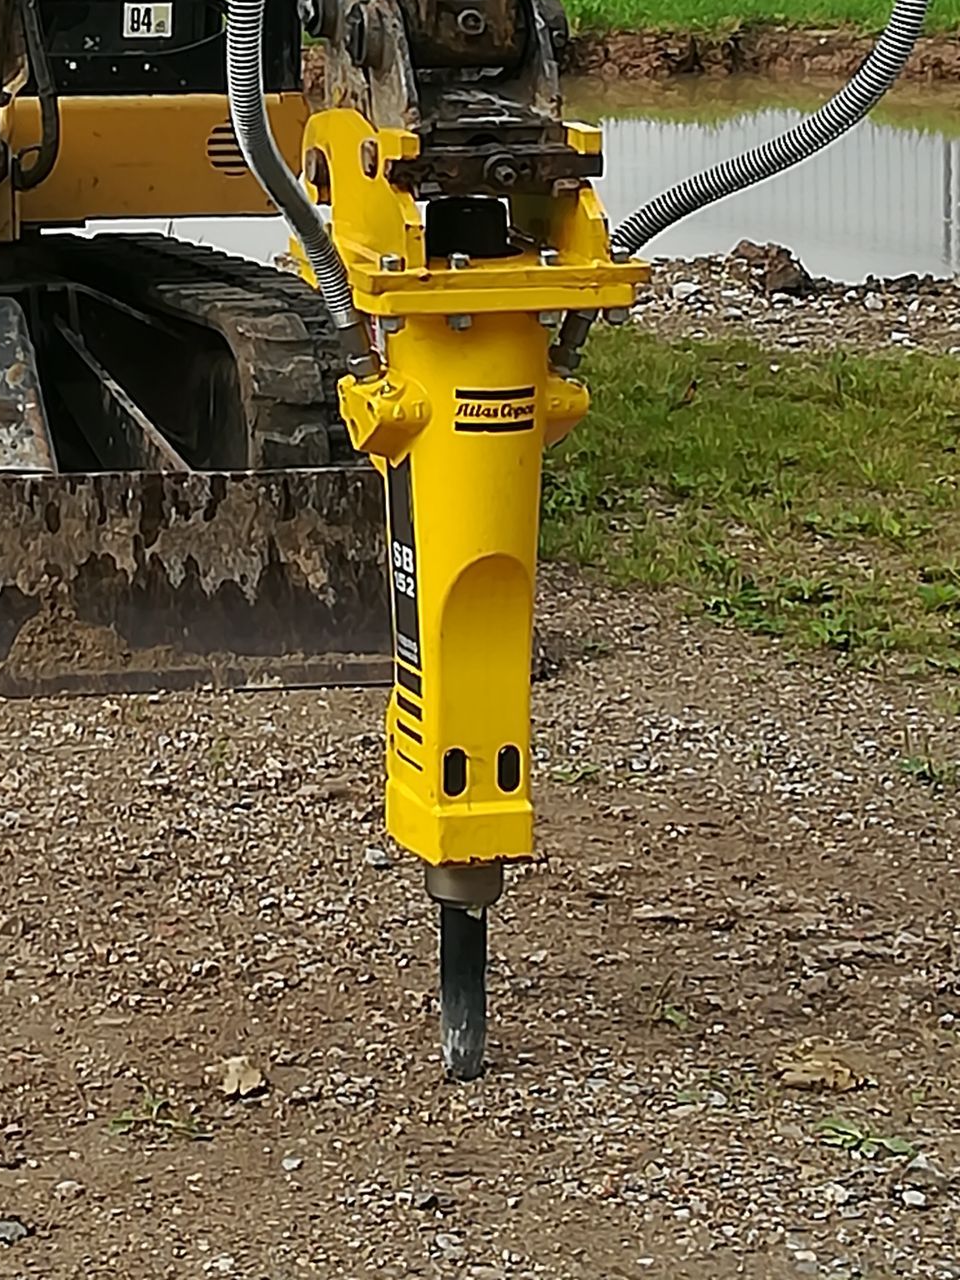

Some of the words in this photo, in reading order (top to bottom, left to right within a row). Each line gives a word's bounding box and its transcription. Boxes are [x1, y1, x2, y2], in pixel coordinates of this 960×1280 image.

[130, 7, 152, 33] 84
[455, 403, 499, 418] Atlas
[393, 541, 414, 573] SB
